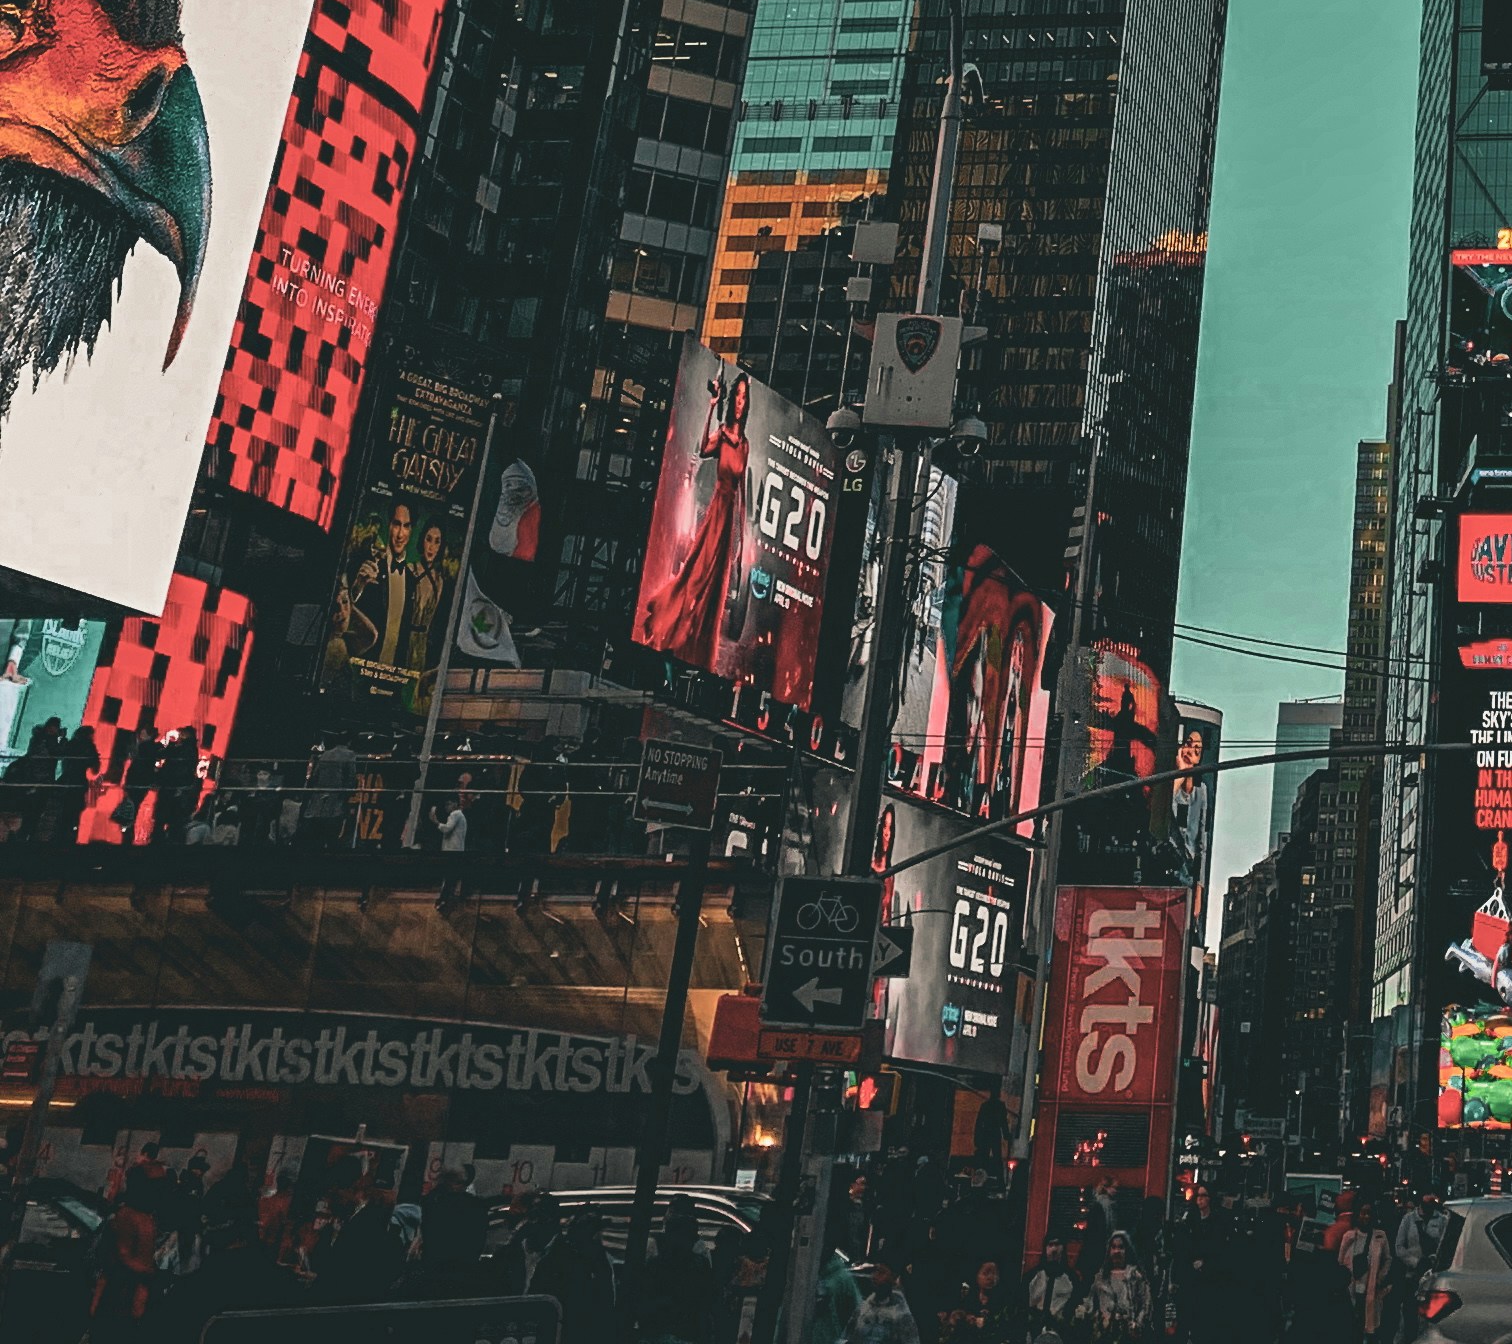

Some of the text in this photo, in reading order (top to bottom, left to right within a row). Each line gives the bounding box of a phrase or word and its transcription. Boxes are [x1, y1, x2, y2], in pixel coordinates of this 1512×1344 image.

[1455, 253, 1473, 261] TRY
[1476, 252, 1495, 261] THE
[282, 247, 346, 298] TURNING
[271, 274, 308, 308] INTO
[415, 388, 473, 416] EXTRAVAGANZA
[434, 381, 447, 394] BIG
[449, 386, 491, 409] BROADWAY
[422, 424, 478, 466] GREAT
[391, 448, 465, 493] GATSBY
[843, 478, 863, 492] LG
[759, 471, 827, 561] G20
[647, 748, 708, 771] NO STOPPING
[1476, 750, 1494, 768] ON
[644, 766, 684, 786] Anytime
[1478, 770, 1492, 788] IN
[949, 899, 1008, 979] G20
[779, 944, 864, 970] South
[1075, 901, 1165, 1095] tkts
[774, 1038, 797, 1053] USE
[820, 1040, 844, 1056] AVE
[510, 1160, 535, 1185] 10
